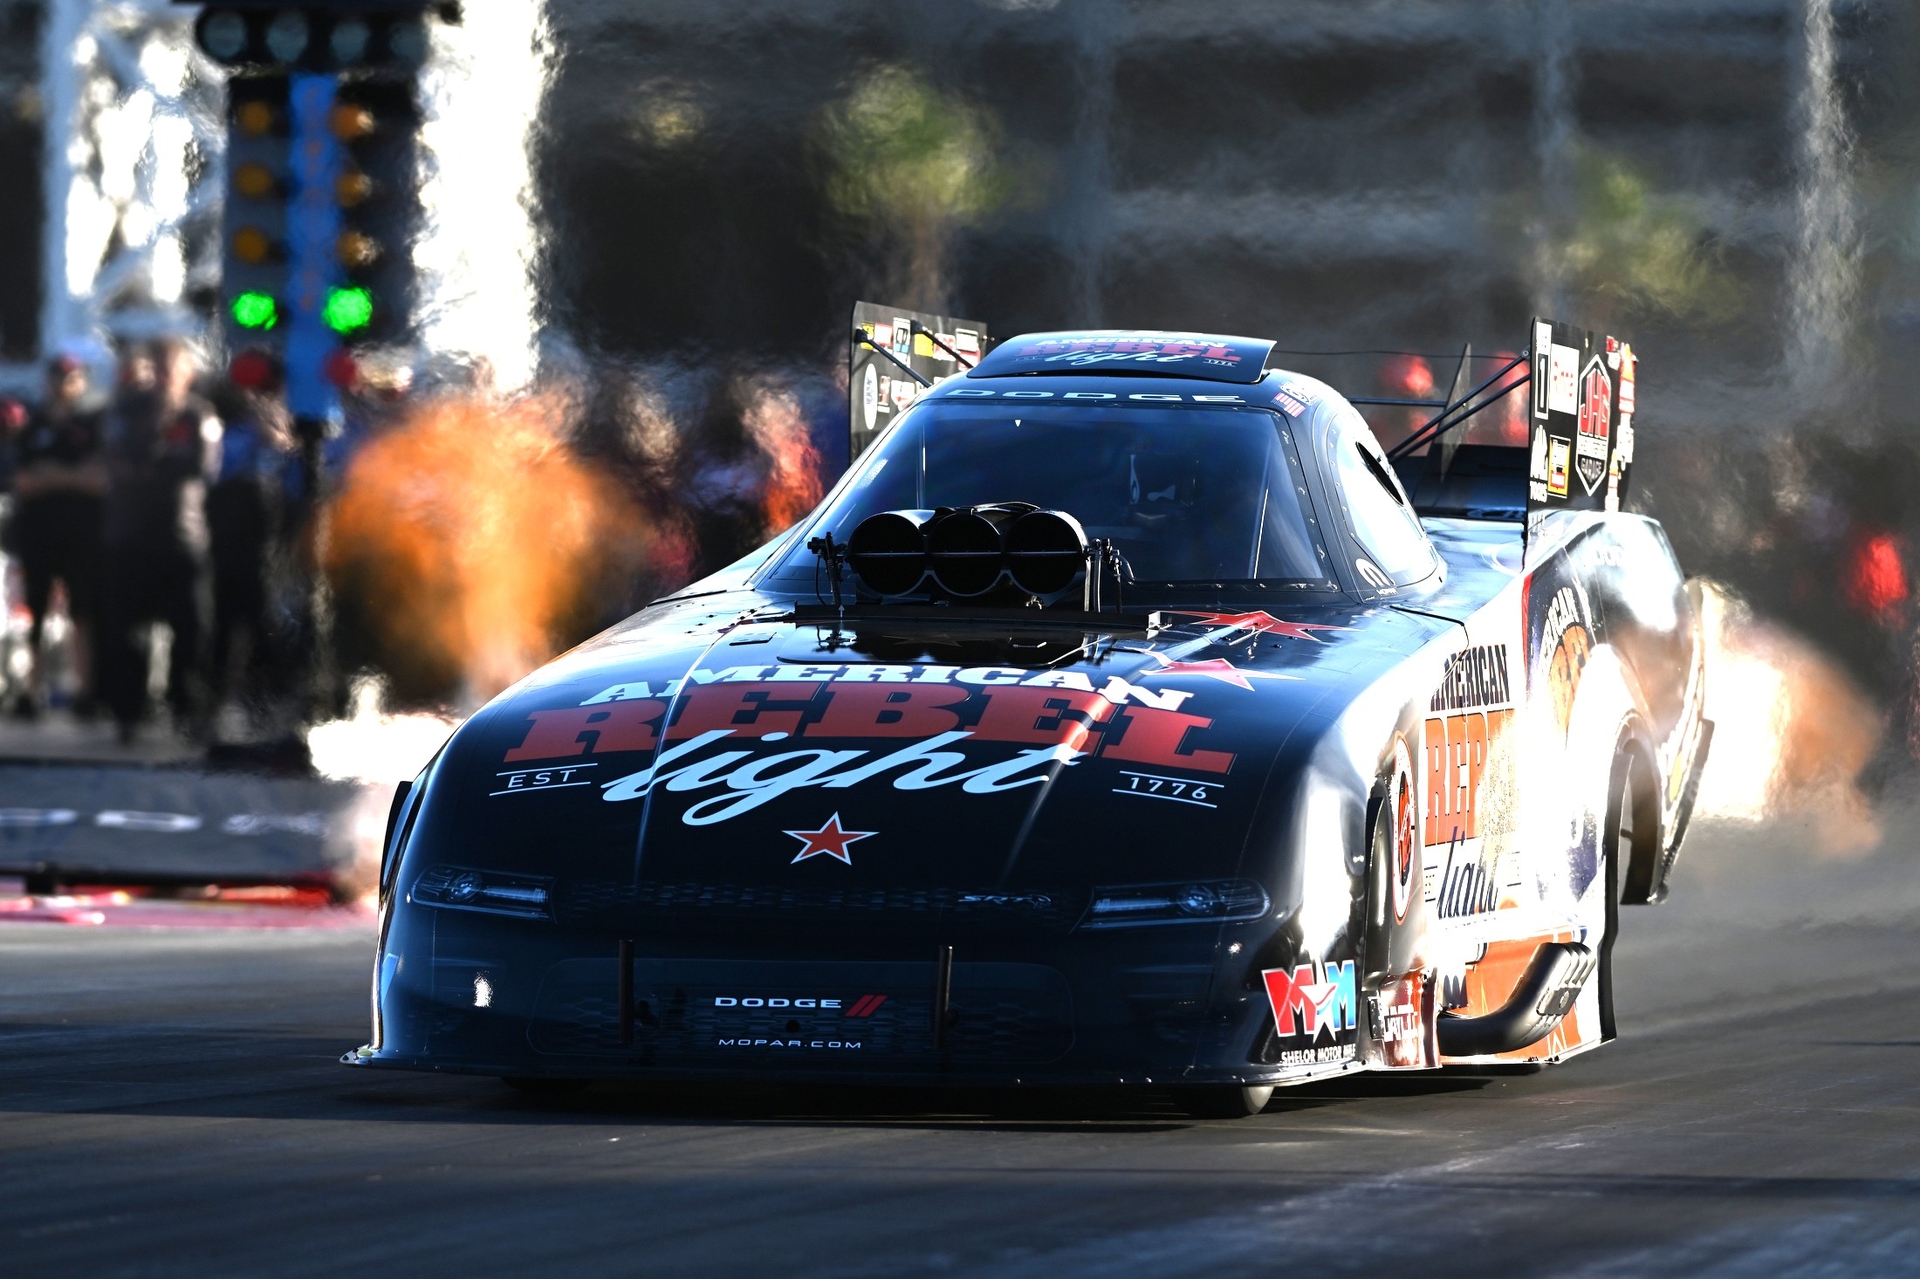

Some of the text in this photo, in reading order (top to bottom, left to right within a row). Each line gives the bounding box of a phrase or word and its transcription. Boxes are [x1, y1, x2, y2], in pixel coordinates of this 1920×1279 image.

[1015, 341, 1243, 362] REBEL
[1035, 337, 1229, 348] AMERICAN
[1044, 350, 1197, 366] light
[945, 389, 1246, 404] DODGE
[1430, 643, 1511, 712] AMERICAN
[579, 664, 1194, 711] AMERICAN
[503, 682, 1238, 775] REBEL
[507, 769, 577, 788] EST
[600, 729, 1089, 826] light
[1130, 776, 1208, 800] 1776
[715, 996, 842, 1009] DODGE
[718, 1038, 862, 1050] MOPAR.COM
[1281, 1049, 1316, 1064] SHELOR
[1317, 1046, 1342, 1061] MOTOR
